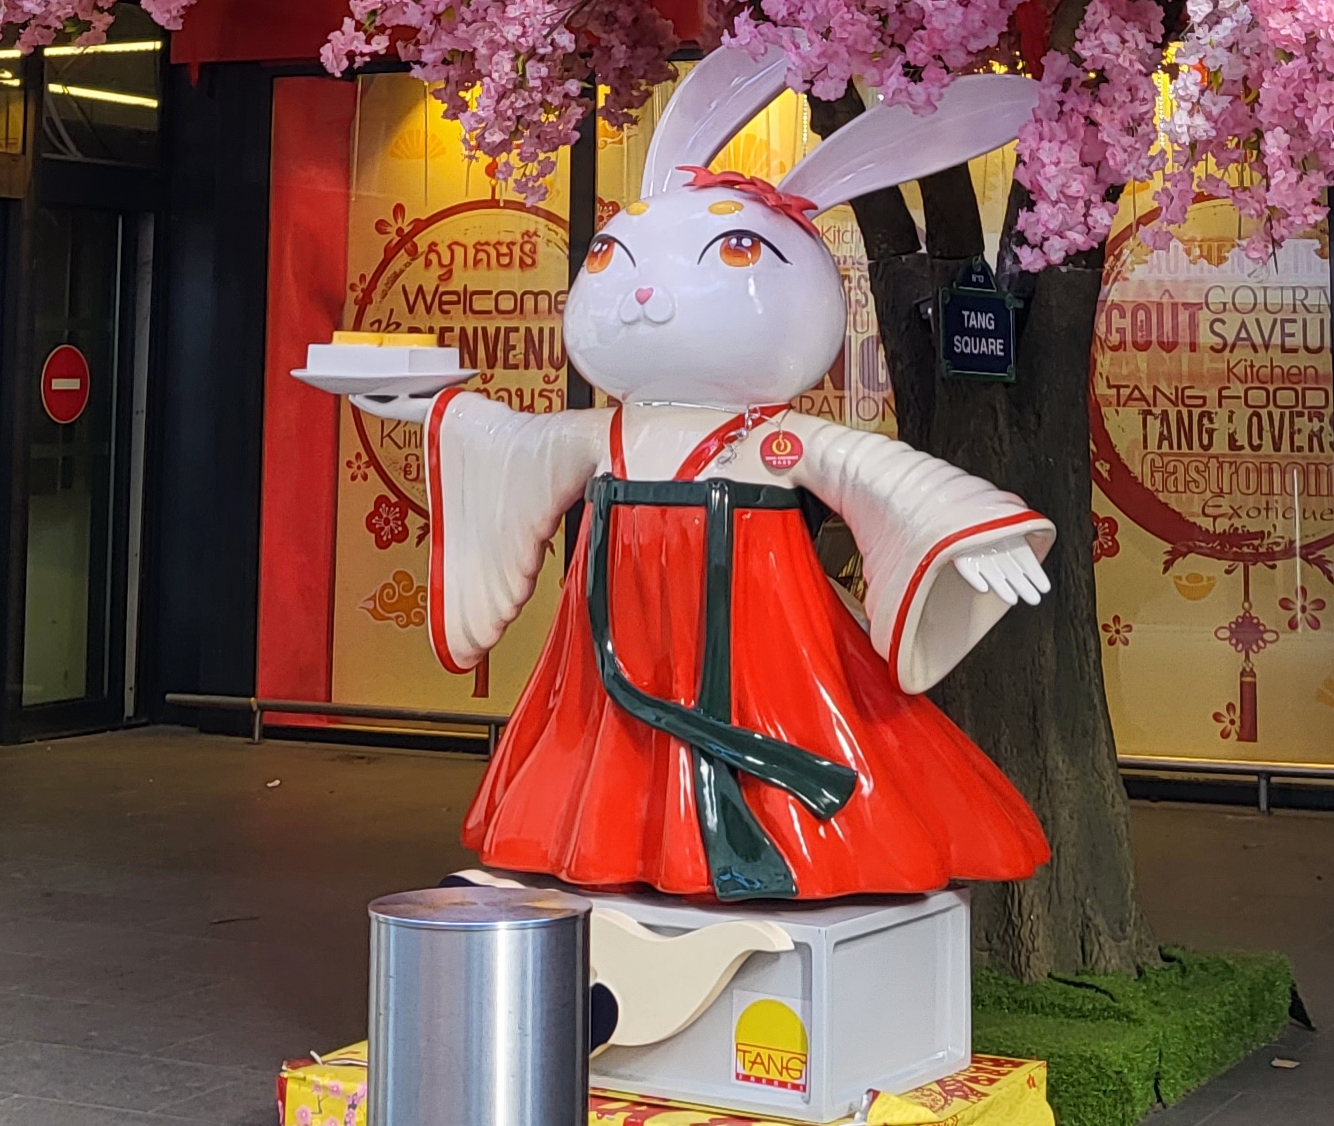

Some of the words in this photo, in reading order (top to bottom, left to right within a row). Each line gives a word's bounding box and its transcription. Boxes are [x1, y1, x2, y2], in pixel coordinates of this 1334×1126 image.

[402, 284, 568, 315] Welcome
[962, 310, 995, 330] TANG
[1105, 289, 1204, 354] GOÛT
[953, 335, 1005, 356] SQUARE
[1227, 357, 1319, 385] Kitchen
[1108, 385, 1207, 409] TANG
[1217, 386, 1330, 410] FOOD
[1139, 409, 1216, 451] TANG
[736, 1049, 806, 1080] TANG
